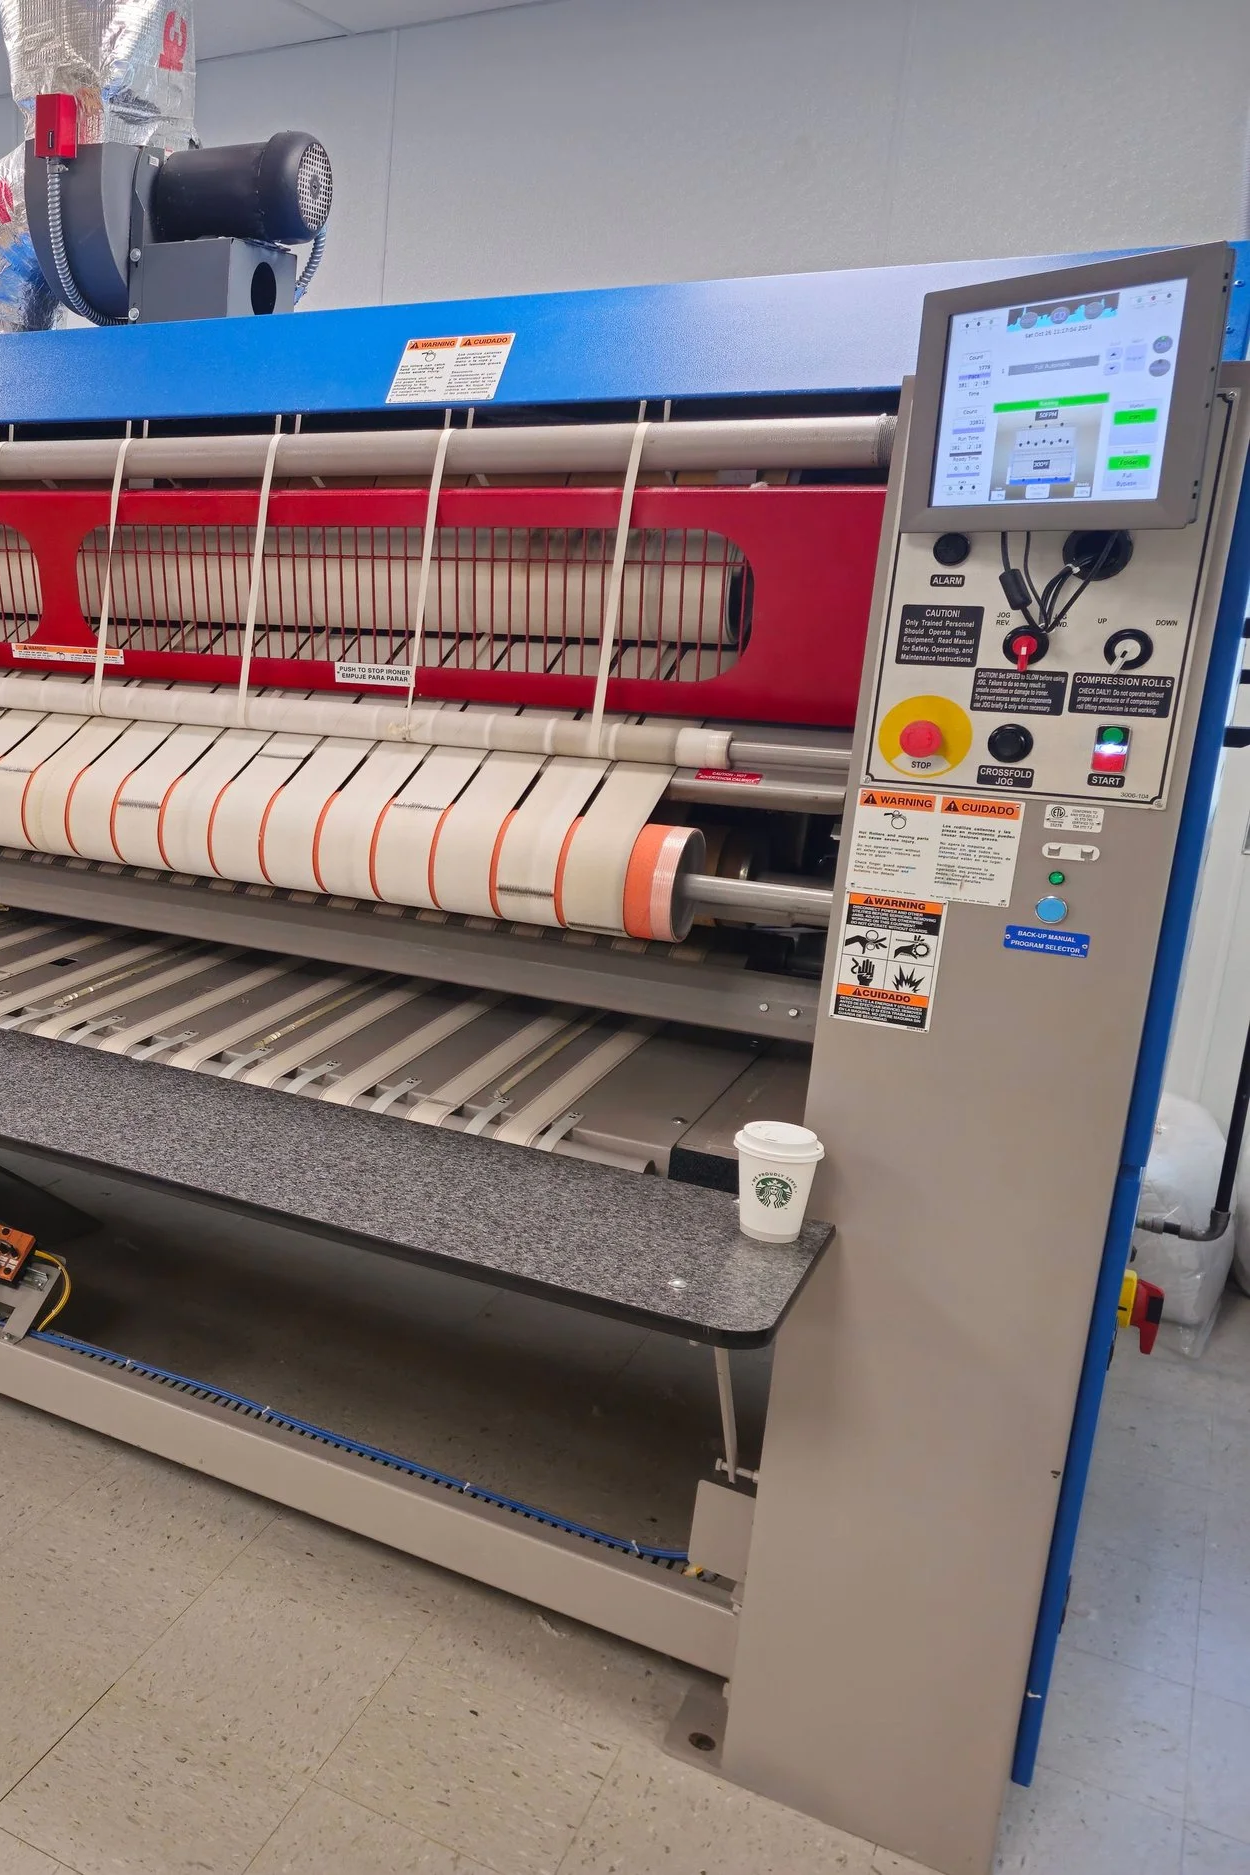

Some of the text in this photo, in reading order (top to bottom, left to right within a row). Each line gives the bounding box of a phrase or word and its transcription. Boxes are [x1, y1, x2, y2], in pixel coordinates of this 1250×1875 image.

[933, 577, 962, 585] ALARM
[926, 609, 960, 617] CAUTION!
[906, 619, 919, 627] Only
[937, 655, 972, 663] Instructions.
[1076, 676, 1171, 687] COMPRESSION ROLLS
[911, 761, 931, 769] STOP
[980, 768, 1032, 778] CROSSFOLD
[1092, 776, 1121, 786] START
[881, 796, 932, 807] WARNING
[962, 803, 1014, 816] CUIDADO
[874, 898, 925, 910] WARNING
[1018, 931, 1076, 943] BACK-UP MANUAL
[1011, 940, 1080, 953] PROGRAM SELECTOR
[862, 990, 910, 1002] CUIDADO
